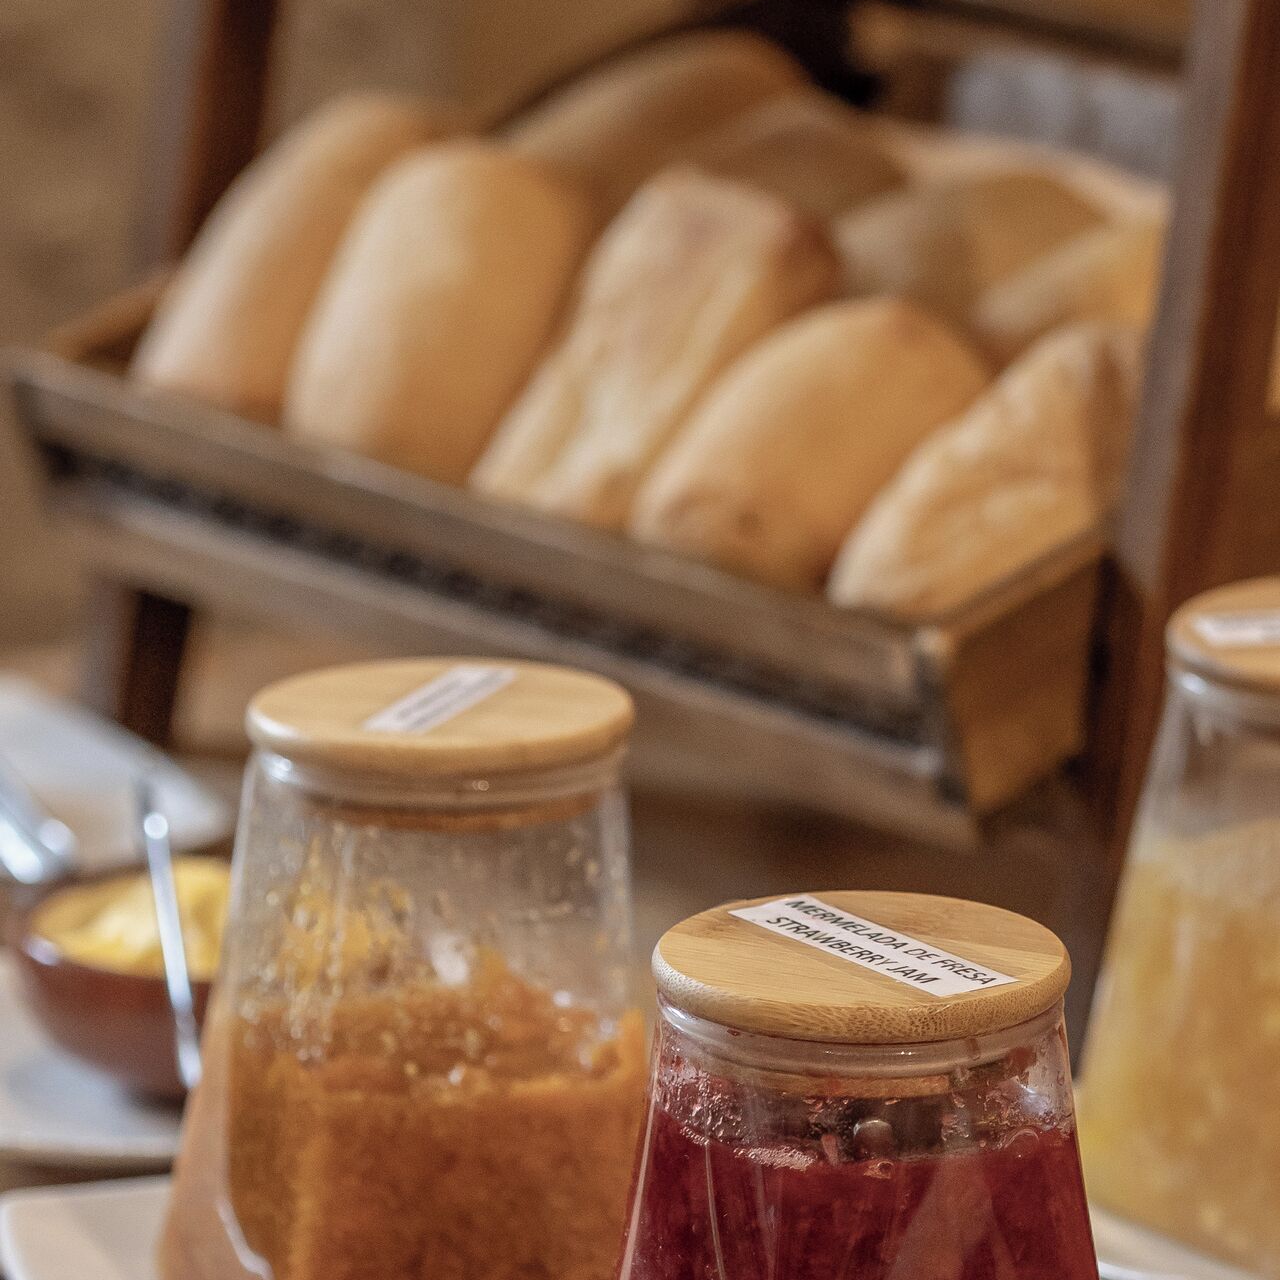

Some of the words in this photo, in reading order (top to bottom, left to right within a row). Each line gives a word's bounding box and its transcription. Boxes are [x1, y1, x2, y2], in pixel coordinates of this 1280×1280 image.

[766, 916, 895, 966] STRAWBERRY
[886, 964, 941, 984] JAM
[785, 900, 904, 950] MERMELADA
[904, 948, 935, 961] DE
[931, 957, 998, 985] FRESA
